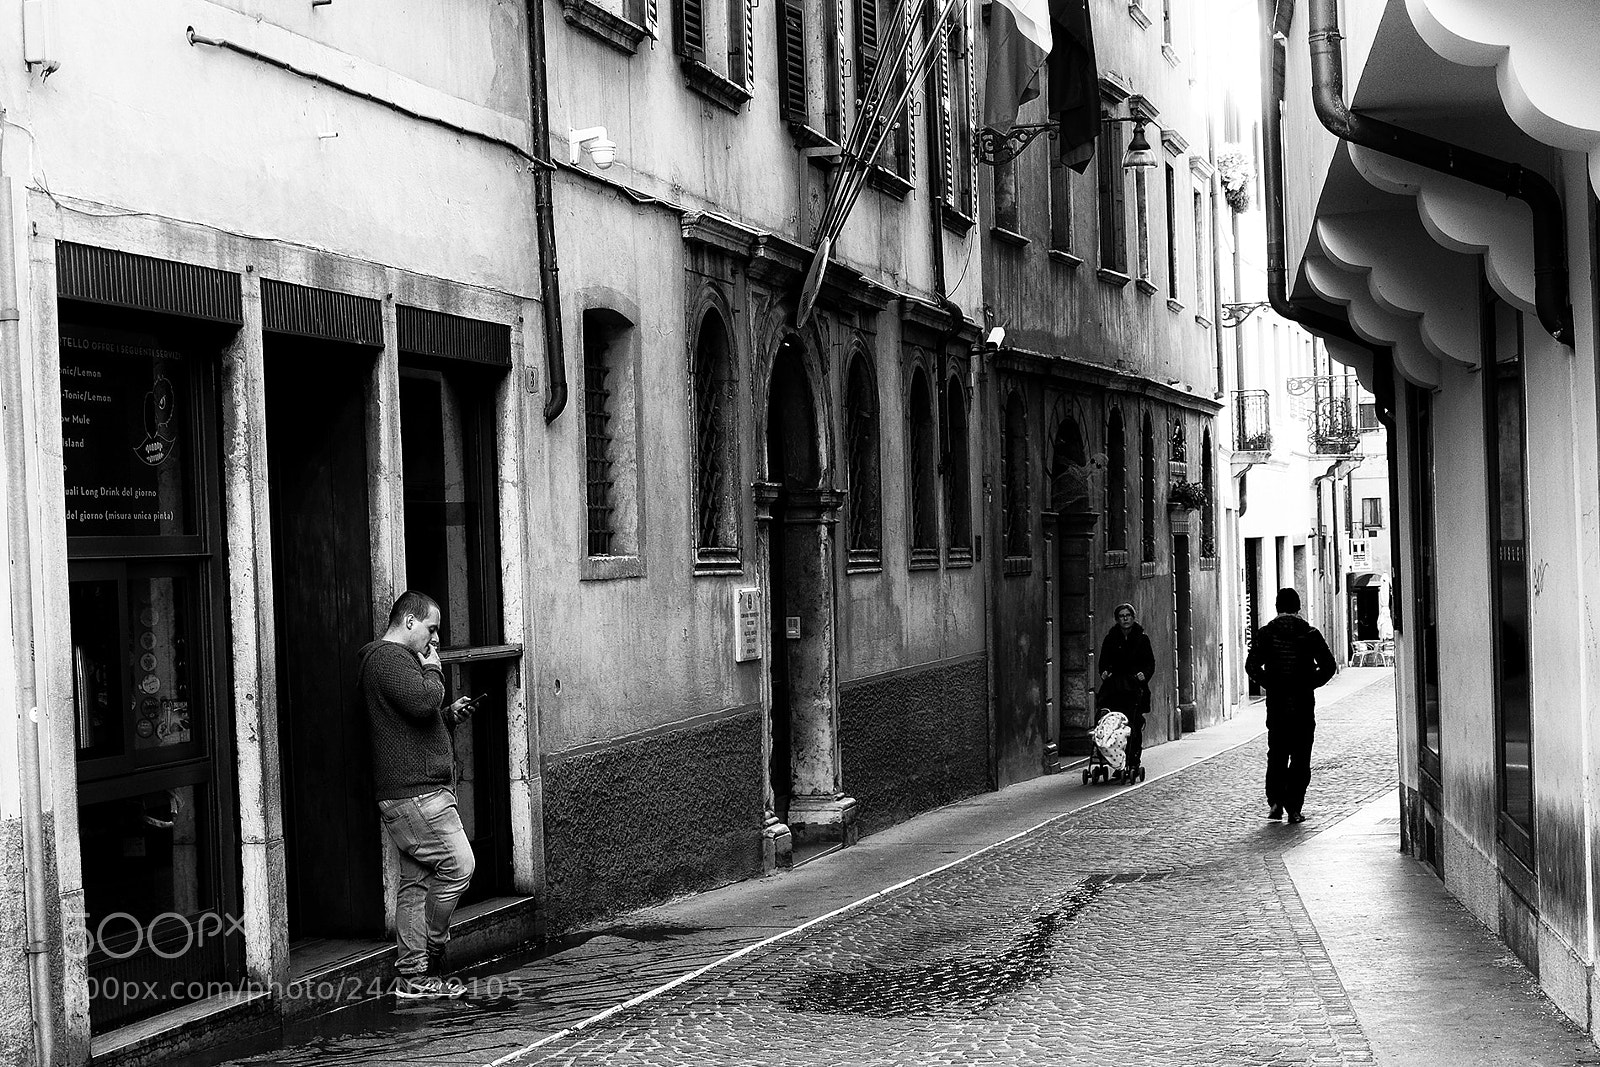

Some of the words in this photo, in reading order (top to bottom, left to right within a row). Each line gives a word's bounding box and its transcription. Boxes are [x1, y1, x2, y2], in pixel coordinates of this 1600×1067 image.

[91, 341, 115, 353] OFFRE
[121, 344, 155, 358] SEGUENTI
[72, 414, 91, 425] Mule
[80, 486, 99, 499] Long
[100, 486, 120, 496] Drink
[121, 487, 133, 497] del
[134, 488, 157, 500] giorno
[66, 509, 78, 520] del
[79, 510, 104, 523] giorno
[105, 510, 132, 521] (misura
[133, 511, 152, 521] unica
[153, 510, 175, 522] pinta)
